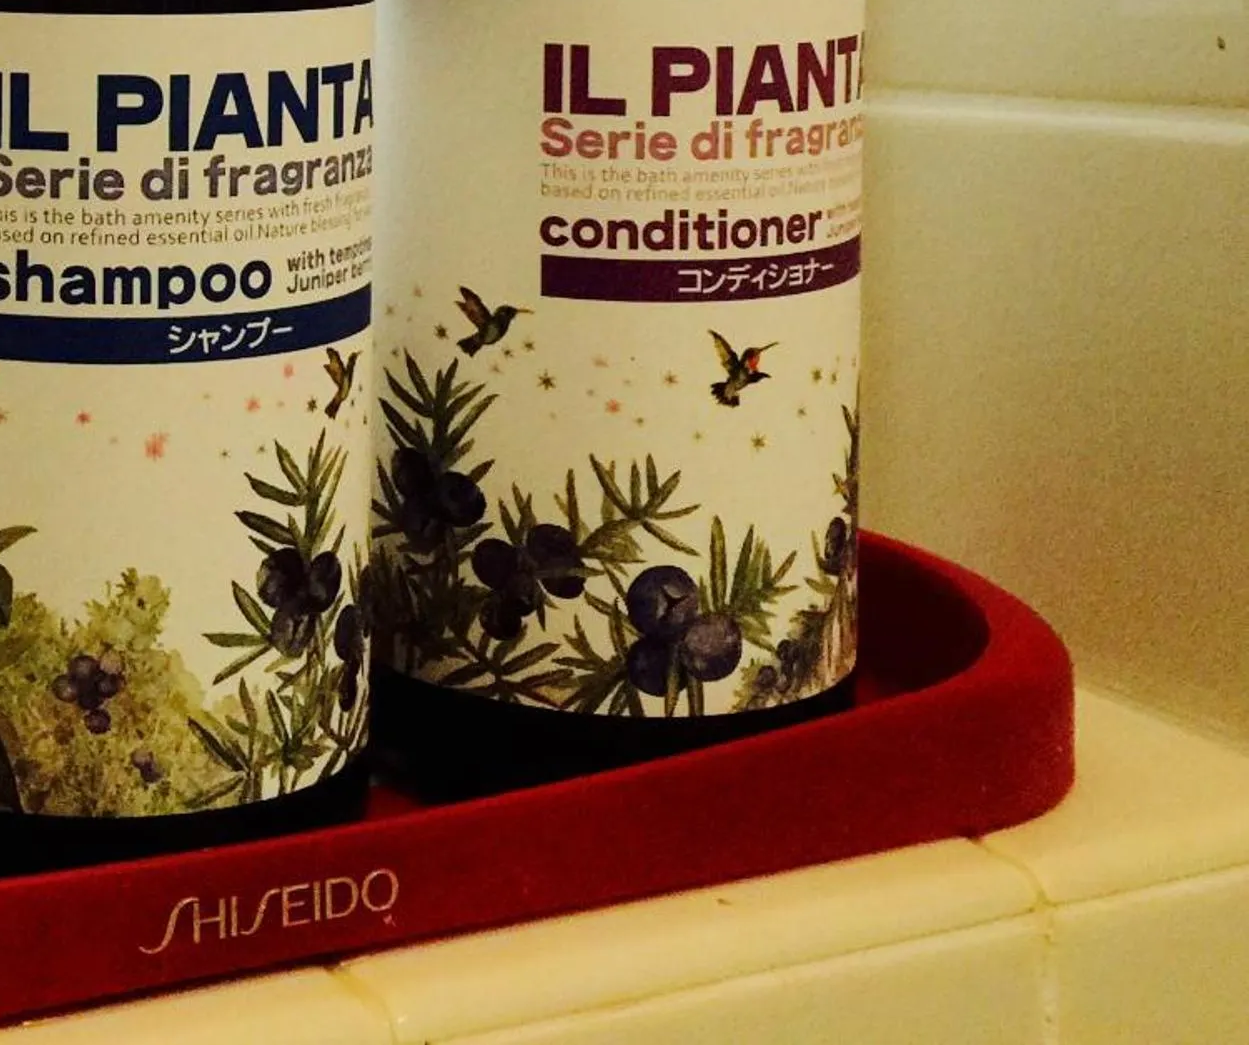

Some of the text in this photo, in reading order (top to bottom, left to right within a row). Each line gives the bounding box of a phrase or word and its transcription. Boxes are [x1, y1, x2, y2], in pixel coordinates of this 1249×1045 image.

[543, 43, 627, 116] IL
[97, 58, 373, 152] PIANTA
[540, 117, 677, 161] Serie
[690, 120, 733, 161] di
[140, 157, 190, 200] di
[539, 163, 577, 181] This
[583, 167, 595, 182] is
[602, 163, 632, 183] the
[636, 166, 677, 183] bath
[682, 167, 749, 186] amenity
[540, 182, 592, 199] based
[598, 187, 620, 201] on
[626, 185, 691, 202] refined
[695, 183, 765, 201] essential
[24, 210, 37, 224] is
[44, 208, 75, 225] the
[82, 207, 131, 226] bath
[132, 208, 210, 227] amenity
[216, 206, 264, 224] series
[267, 200, 300, 219] with
[539, 209, 823, 252] conditioner
[40, 232, 64, 245] on
[71, 229, 140, 246] refined
[146, 226, 228, 246] essential
[287, 248, 325, 272] with
[677, 257, 834, 294] コンディショナー
[287, 264, 348, 294] Juniper
[167, 317, 293, 355] シャンプー
[138, 868, 400, 954] SHISEIDO
